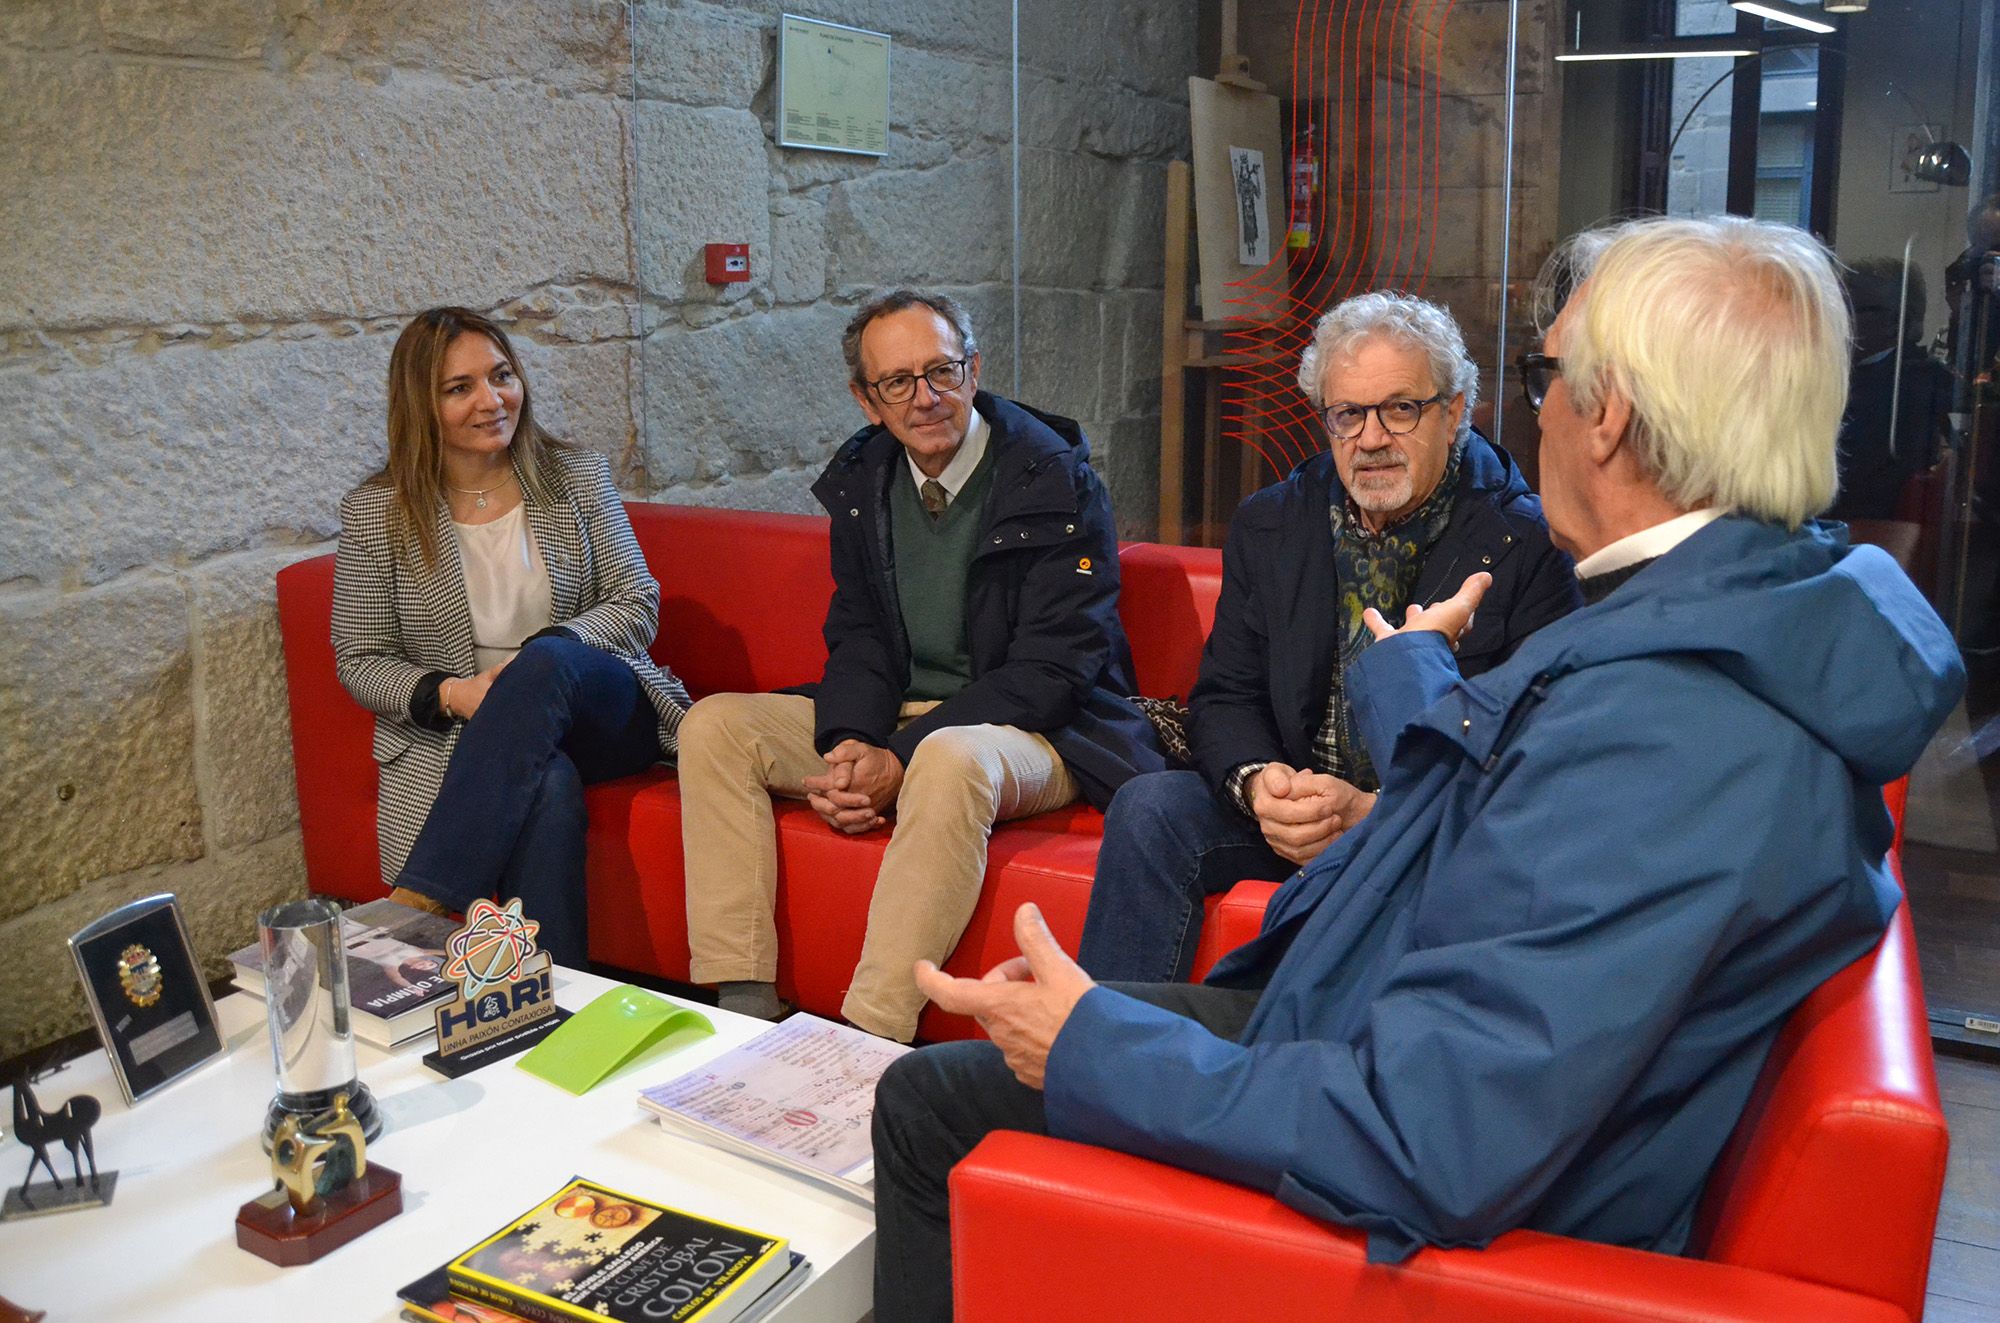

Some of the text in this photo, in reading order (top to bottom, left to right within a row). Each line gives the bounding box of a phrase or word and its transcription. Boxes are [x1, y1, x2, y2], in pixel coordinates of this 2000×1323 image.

[367, 980, 432, 1008] OLIMPIA
[441, 972, 551, 1038] HQR!
[444, 1039, 468, 1052] UNHA
[501, 1005, 552, 1030] CONTAXIOSA
[562, 1241, 645, 1300] EL NOBLE GALLEGO
[571, 1290, 591, 1303] QUE
[596, 1243, 674, 1298] LA CLAVE DE
[615, 1236, 713, 1306] CRISTÓBAL
[642, 1241, 747, 1317] COLÓN
[671, 1296, 705, 1320] CARLOS
[702, 1286, 716, 1297] DE
